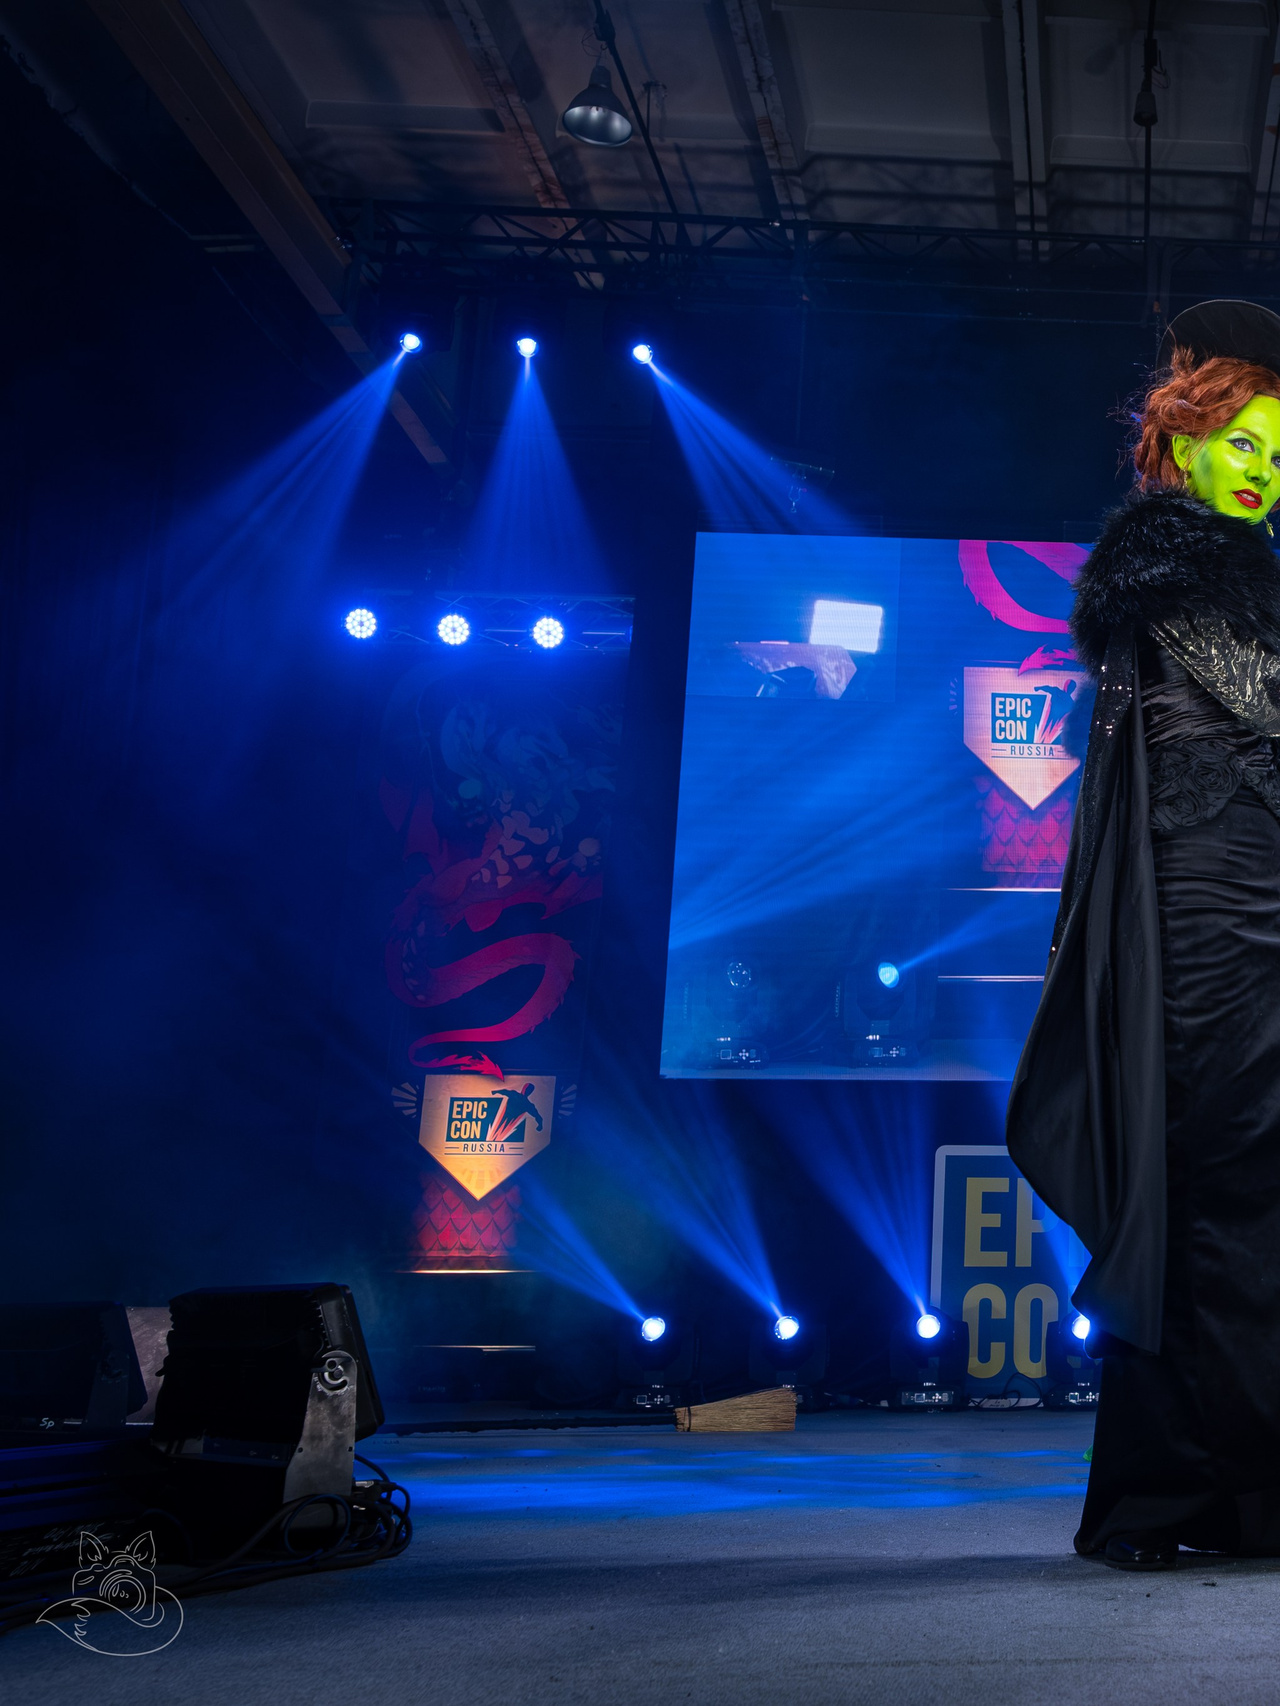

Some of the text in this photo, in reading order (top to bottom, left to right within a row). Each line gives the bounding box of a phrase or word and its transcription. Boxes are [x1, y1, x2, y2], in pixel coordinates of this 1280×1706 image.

[995, 697, 1032, 718] EPIC
[995, 720, 1027, 740] CON
[1010, 745, 1054, 756] RUSSIA
[452, 1101, 488, 1119] EPIC
[450, 1120, 482, 1139] CON
[462, 1143, 505, 1152] RUSSIA
[962, 1283, 1102, 1379] CO
